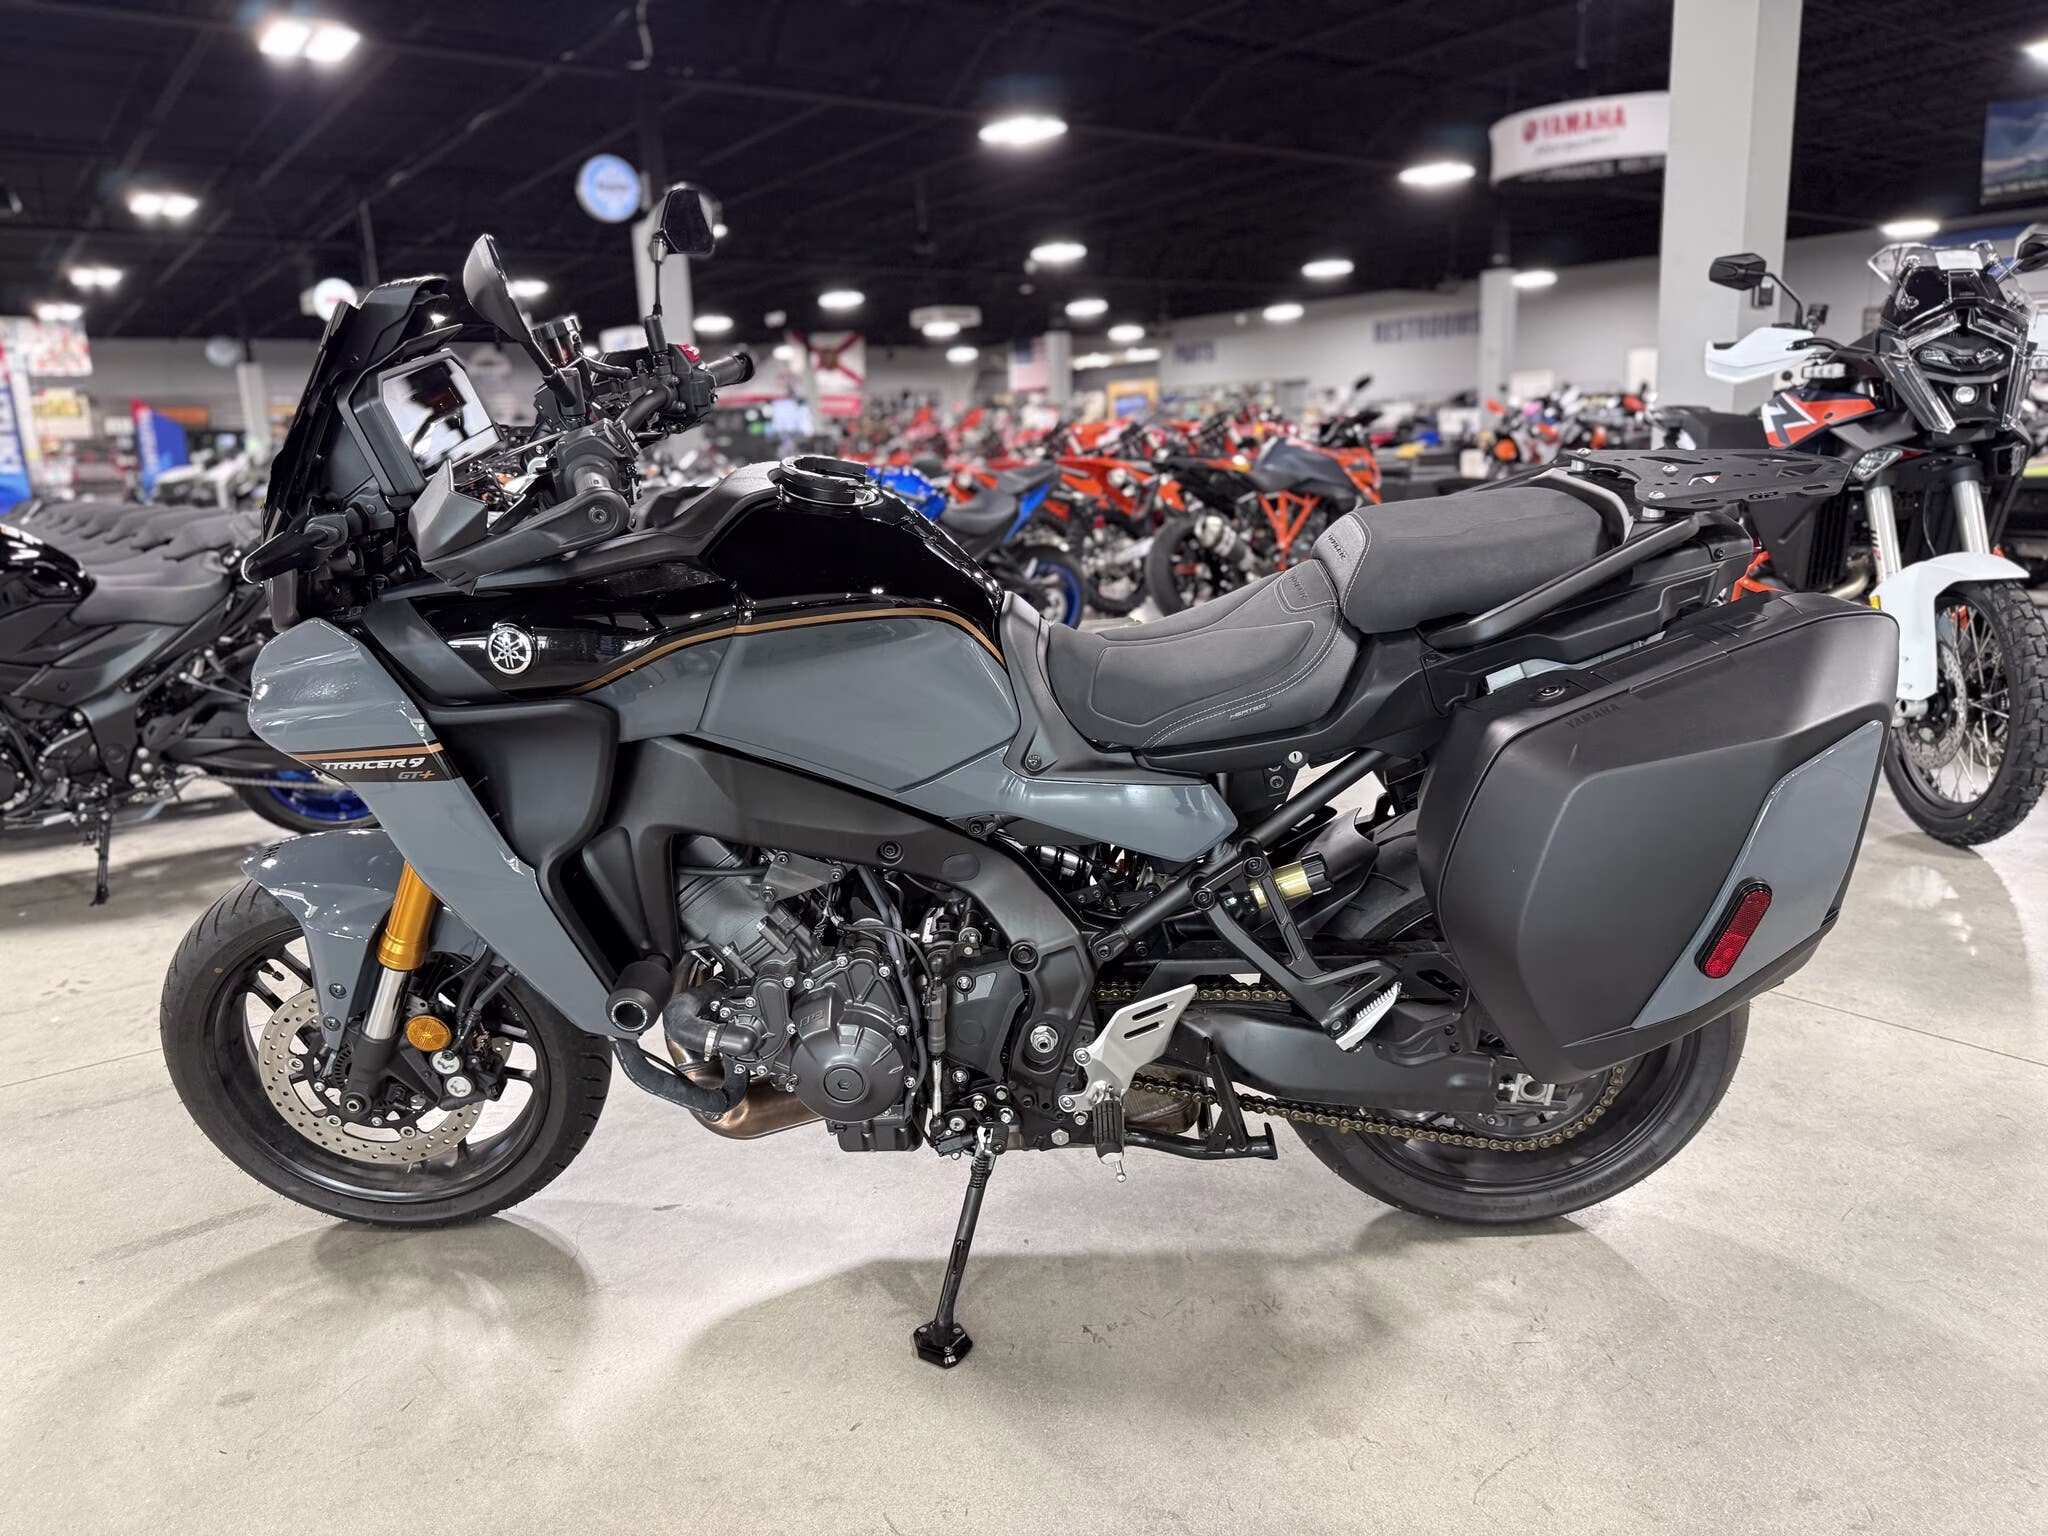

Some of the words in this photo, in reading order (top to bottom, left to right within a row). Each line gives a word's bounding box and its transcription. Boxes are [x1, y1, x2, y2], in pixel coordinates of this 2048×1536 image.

[1542, 105, 1626, 137] YAMAHA
[1565, 703, 1621, 728] YAMAHA
[321, 758, 408, 770] TRACER
[409, 757, 426, 769] 9
